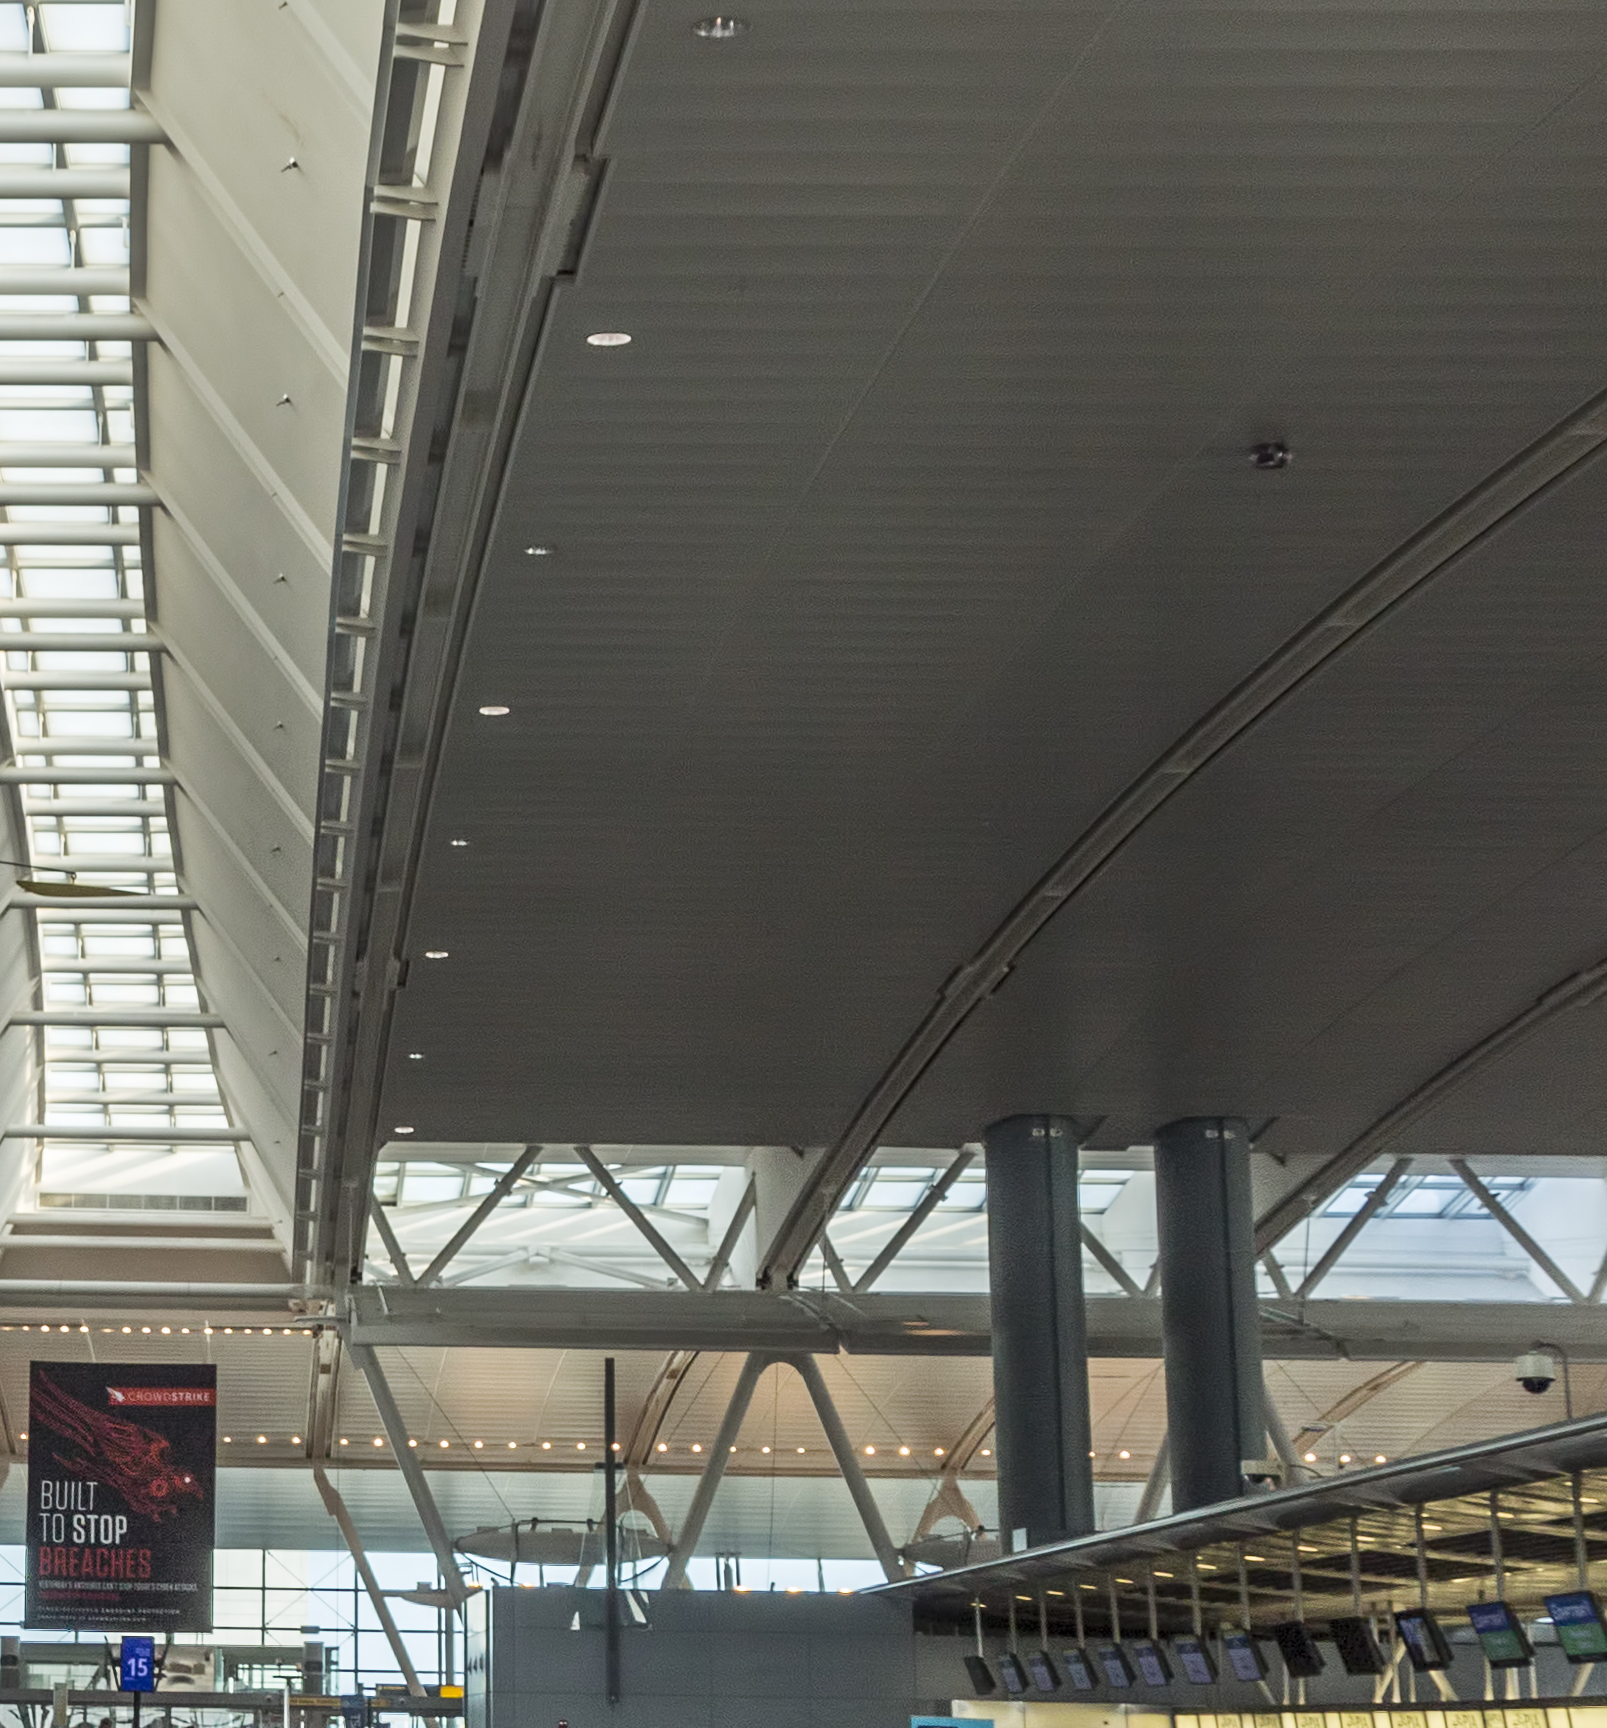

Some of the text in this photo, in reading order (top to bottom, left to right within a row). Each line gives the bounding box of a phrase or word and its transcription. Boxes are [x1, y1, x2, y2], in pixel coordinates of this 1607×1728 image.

[129, 1391, 211, 1402] CROWDSTRIKE
[40, 1480, 99, 1511] BUILT
[39, 1512, 128, 1545] TO STOP
[38, 1546, 152, 1579] BREACHES
[127, 1657, 148, 1677] 15
